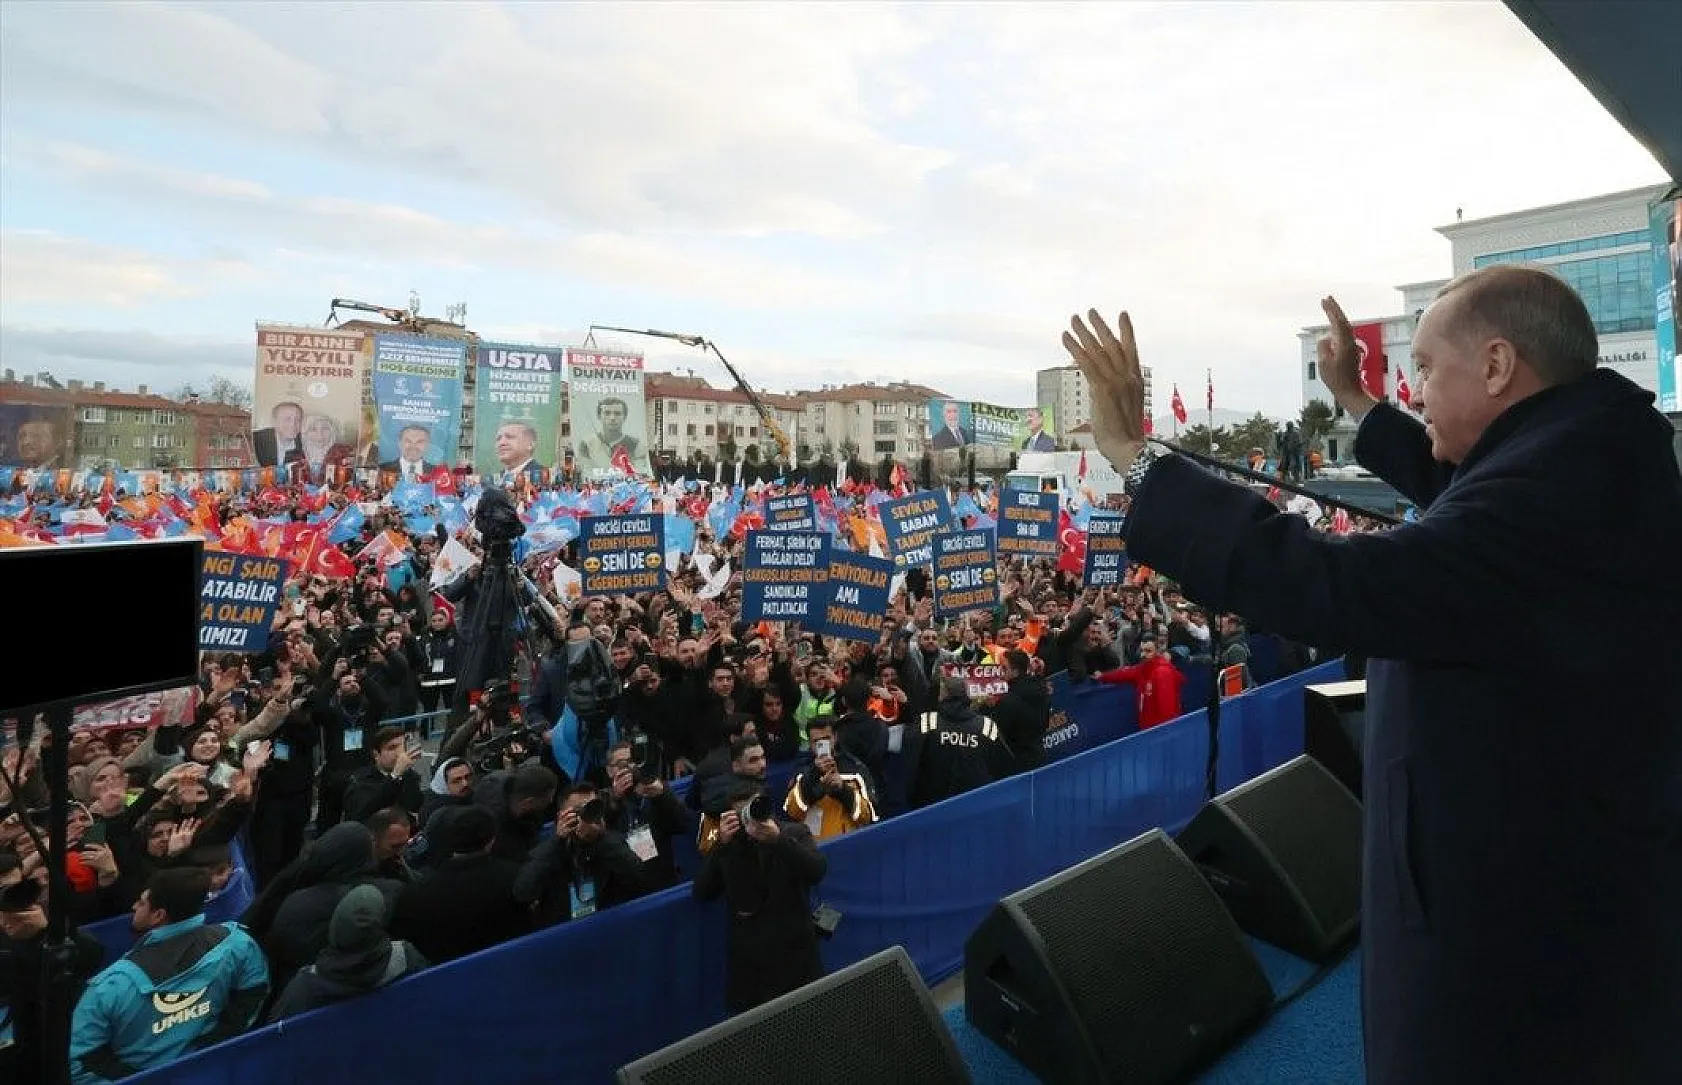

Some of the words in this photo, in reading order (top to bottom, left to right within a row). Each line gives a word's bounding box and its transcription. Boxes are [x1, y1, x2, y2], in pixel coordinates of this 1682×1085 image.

[299, 335, 357, 350] ANNE
[489, 350, 552, 370] USTA
[240, 559, 280, 581] ŞAİR
[629, 552, 645, 569] DE
[971, 567, 983, 587] DE
[835, 586, 860, 605] AMA
[201, 603, 214, 621] A
[218, 604, 265, 624] OLAN
